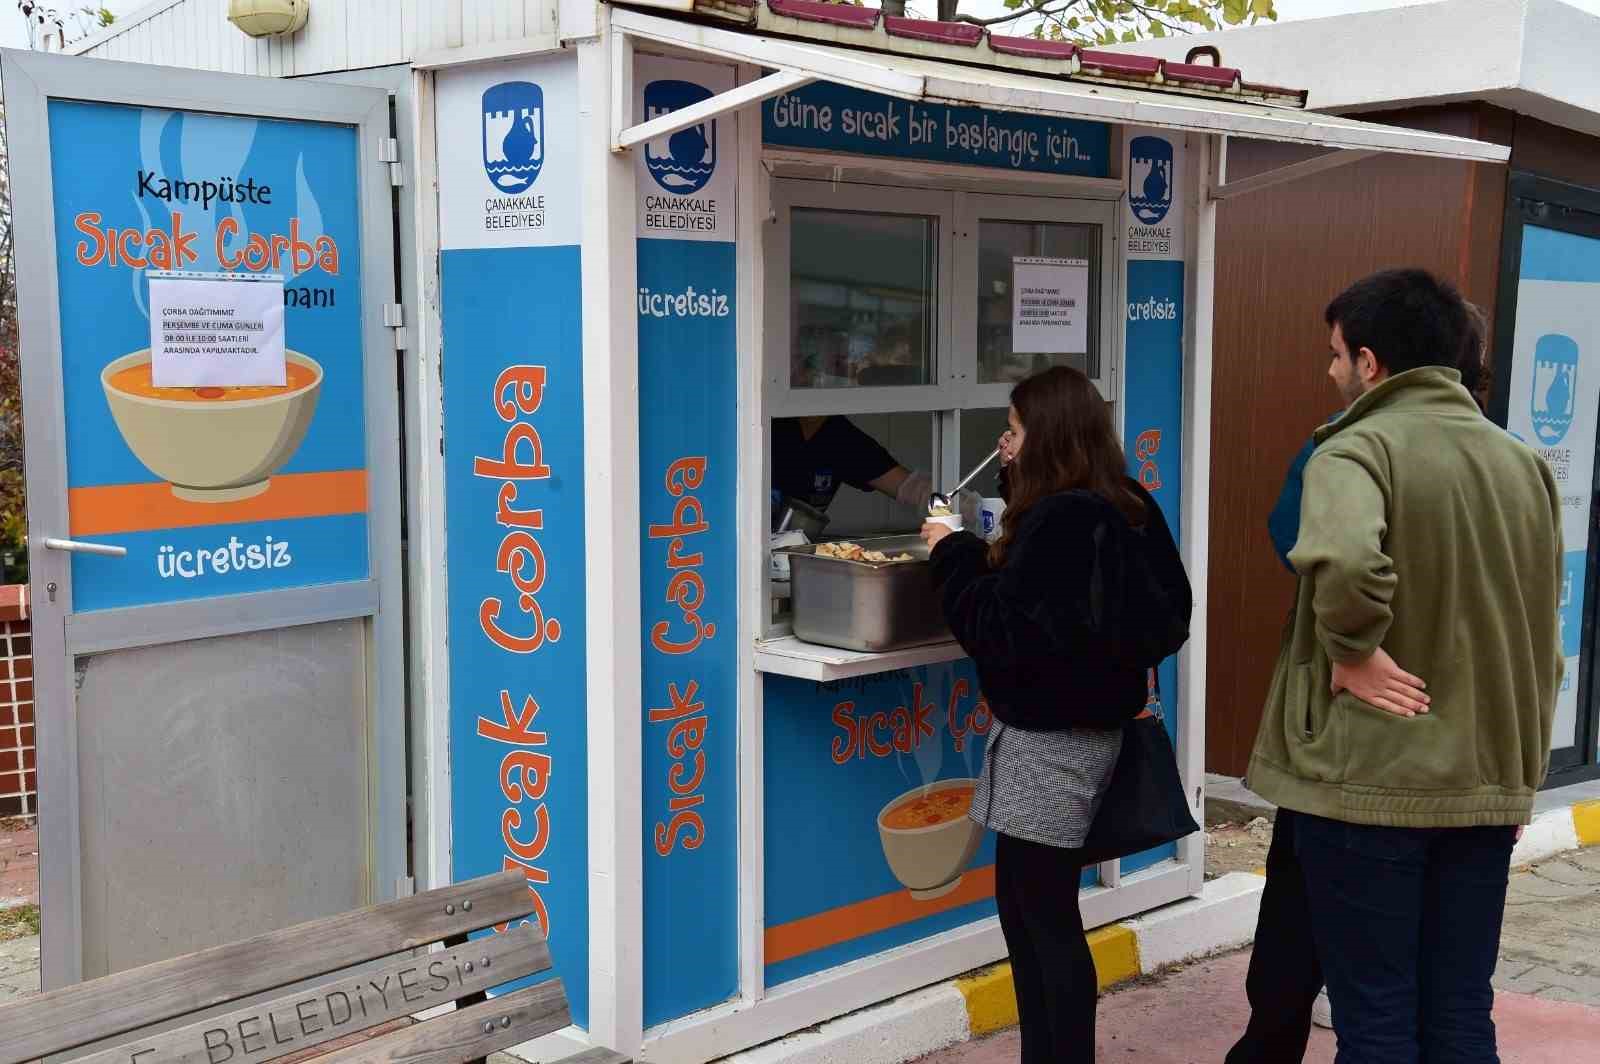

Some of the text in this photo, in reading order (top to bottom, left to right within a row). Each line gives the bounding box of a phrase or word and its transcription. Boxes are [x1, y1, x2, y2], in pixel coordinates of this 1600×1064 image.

[773, 94, 833, 134] Güne
[841, 101, 901, 141] sıcak
[908, 104, 938, 145] bir
[945, 109, 1040, 168] başlangıç
[137, 170, 272, 210] Kampüste
[485, 196, 545, 213] ÇANAKKALE
[645, 196, 716, 213] ÇANAKKALE
[485, 212, 545, 229] BELEDİYESİ
[645, 213, 716, 230] BELEDİYESİ
[74, 211, 199, 272] Sıcak
[638, 286, 730, 318] ücretsiz
[1127, 295, 1177, 321] cretsiz
[157, 535, 292, 578] ücretsiz
[473, 365, 562, 940] ıcak Çorba
[648, 455, 716, 857] Sıcak Çorba
[831, 682, 937, 765] Sıcak
